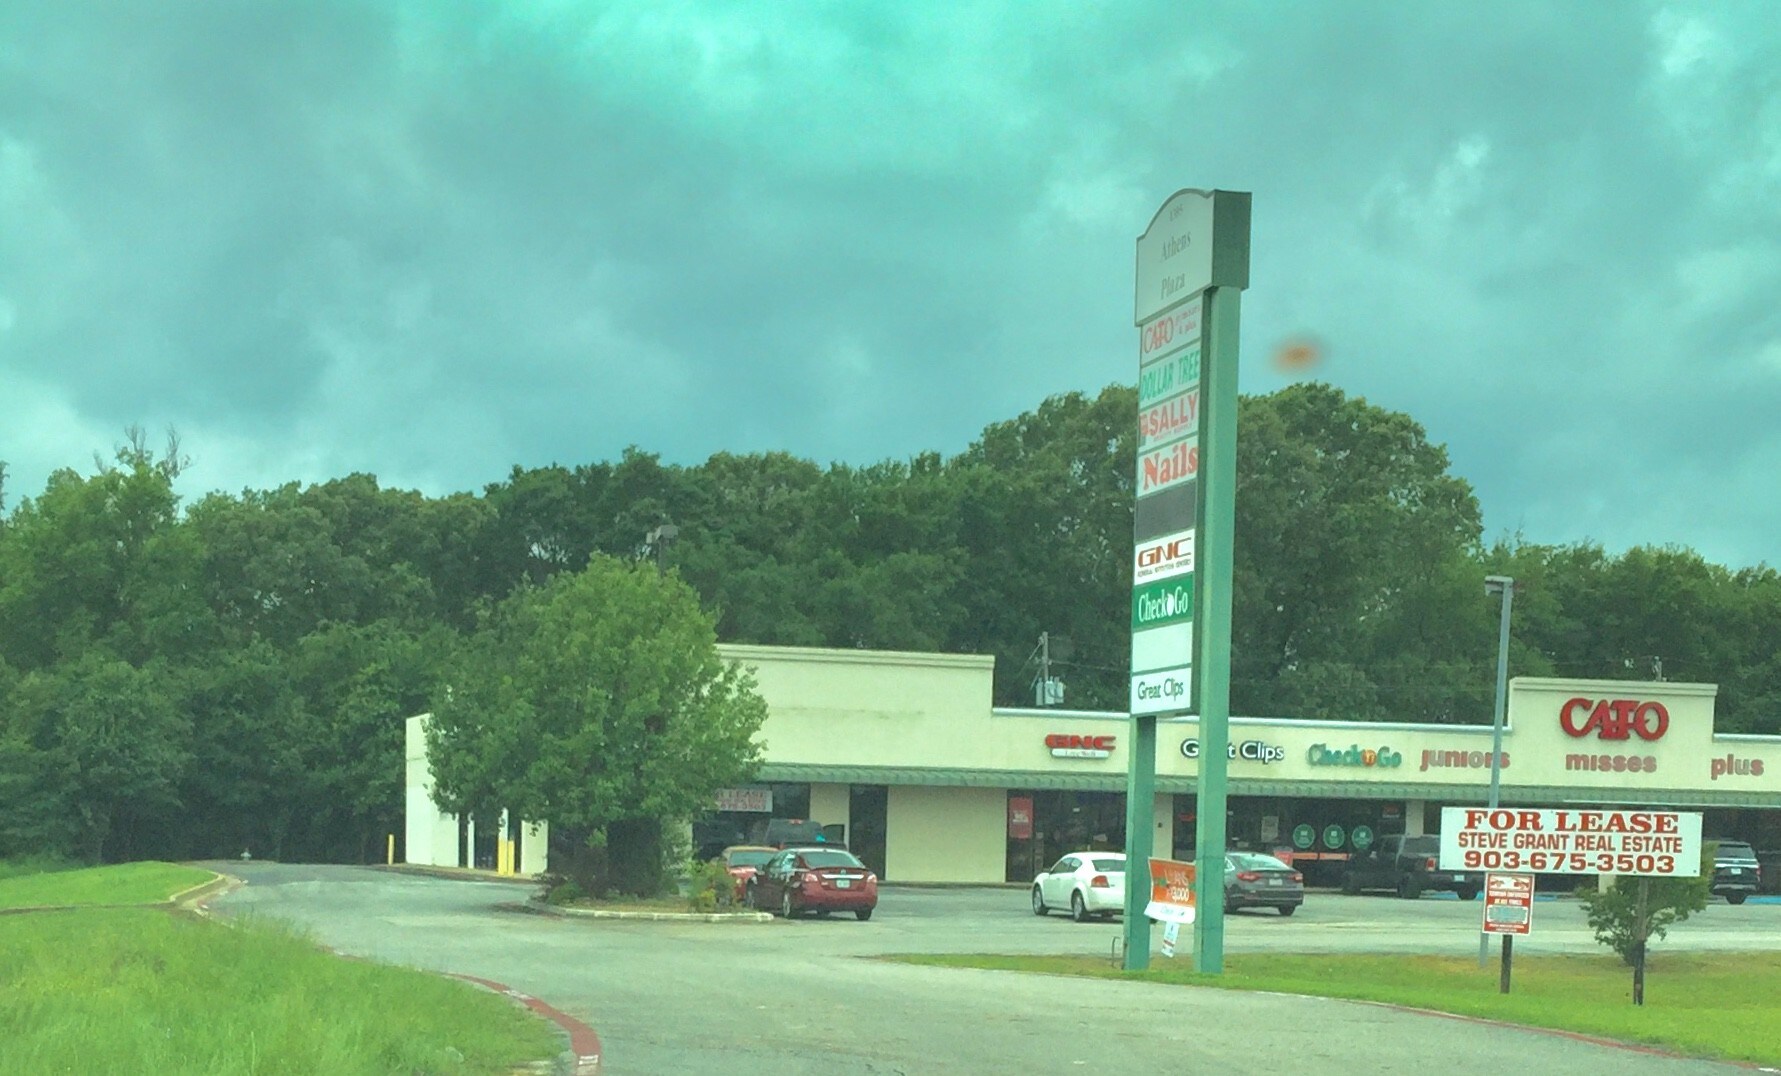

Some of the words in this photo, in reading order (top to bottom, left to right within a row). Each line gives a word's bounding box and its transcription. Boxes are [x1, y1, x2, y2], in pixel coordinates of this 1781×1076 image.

[1161, 231, 1192, 261] Athens
[1161, 273, 1185, 300] Plaza
[1144, 317, 1173, 353] CATO
[1149, 391, 1199, 437] SALLY
[1143, 442, 1198, 491] Nails
[1138, 537, 1192, 568] GNC
[1138, 589, 1168, 622] Check
[1174, 586, 1189, 615] Go
[1138, 681, 1162, 700] Great
[1164, 678, 1184, 702] Clips
[1560, 697, 1670, 742] CATO
[1045, 734, 1117, 751] GNC
[1240, 740, 1285, 764] Clips
[1565, 754, 1658, 773] misses
[1711, 754, 1764, 780] plus
[1464, 810, 1544, 832] FOR
[1555, 811, 1679, 834] LEASE
[1458, 831, 1508, 848] STEVE
[1513, 833, 1570, 850] GRANT
[1575, 834, 1616, 851] REAL
[1622, 836, 1683, 853] ESTATE
[1464, 850, 1675, 874] 903-675-3503
